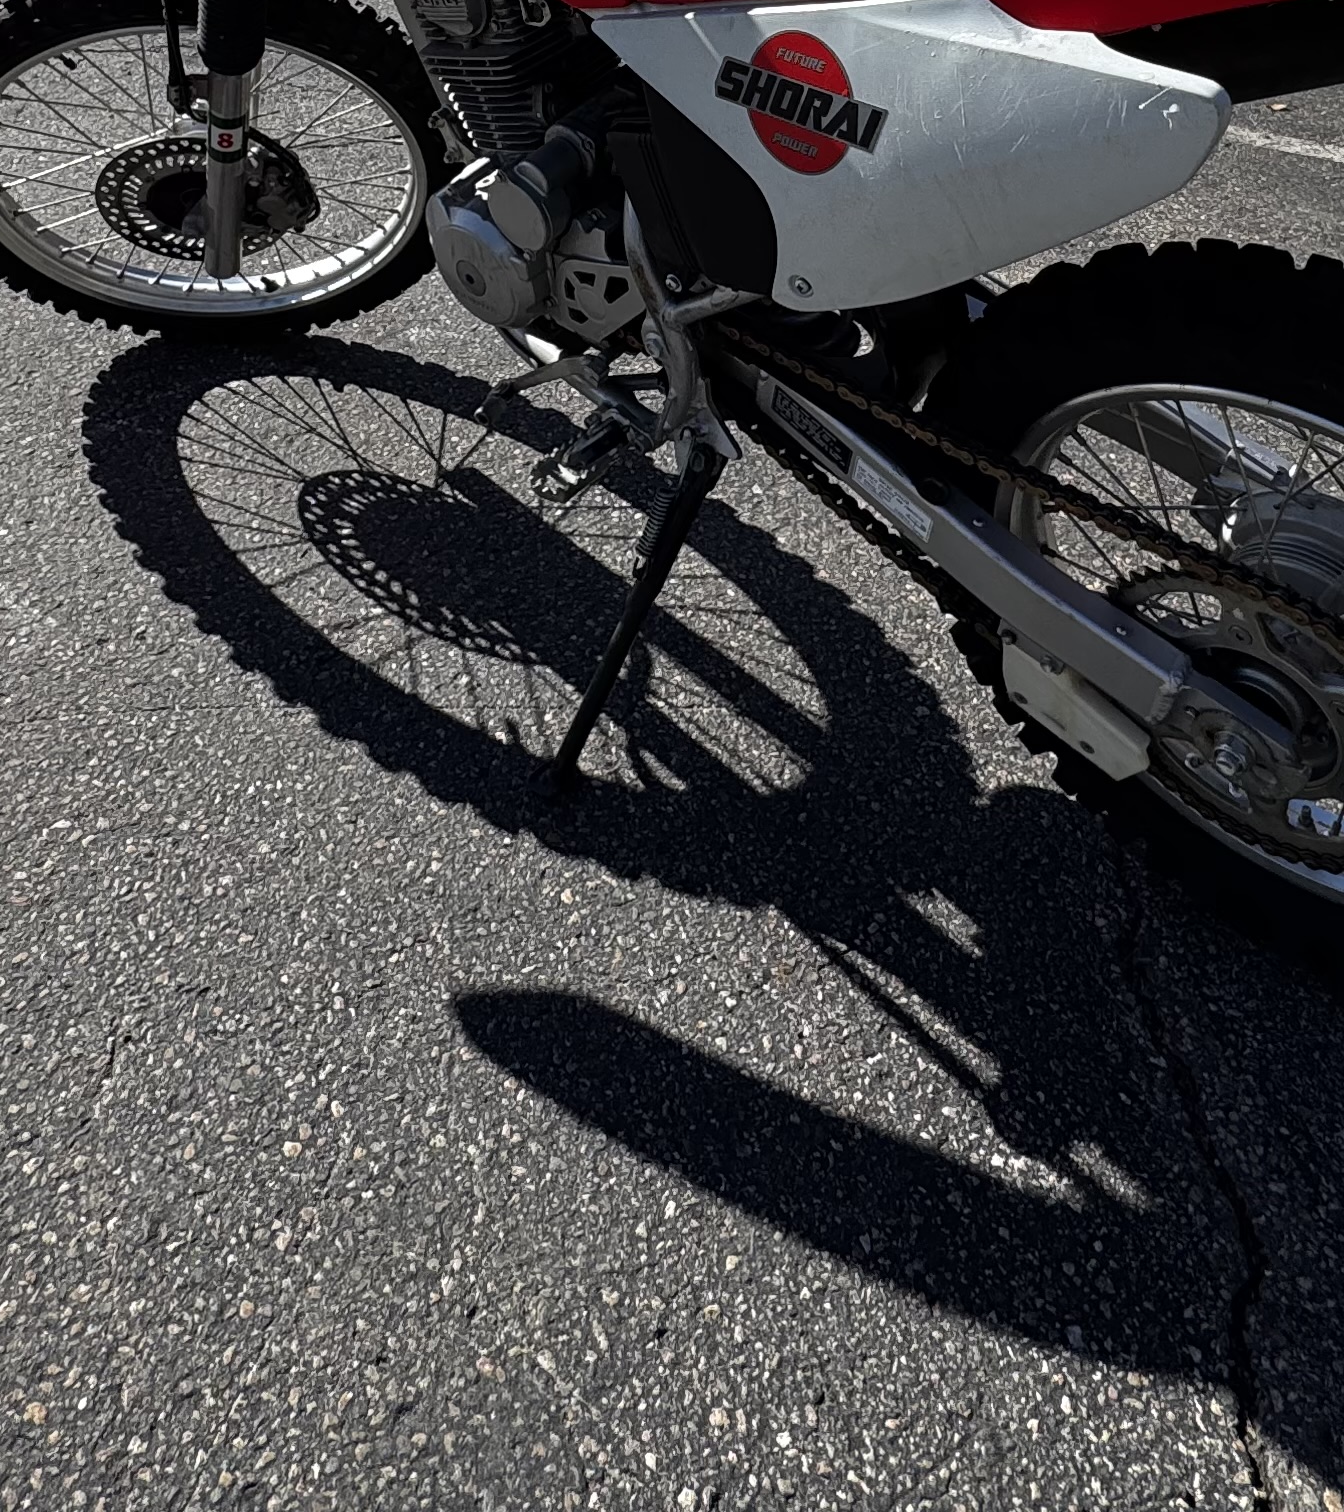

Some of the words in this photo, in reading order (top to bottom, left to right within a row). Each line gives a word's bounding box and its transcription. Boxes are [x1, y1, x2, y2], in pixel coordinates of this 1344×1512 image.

[774, 47, 828, 74] FUTURE
[716, 59, 885, 151] SHORAI
[217, 133, 234, 149] 8
[771, 132, 819, 159] POWER
